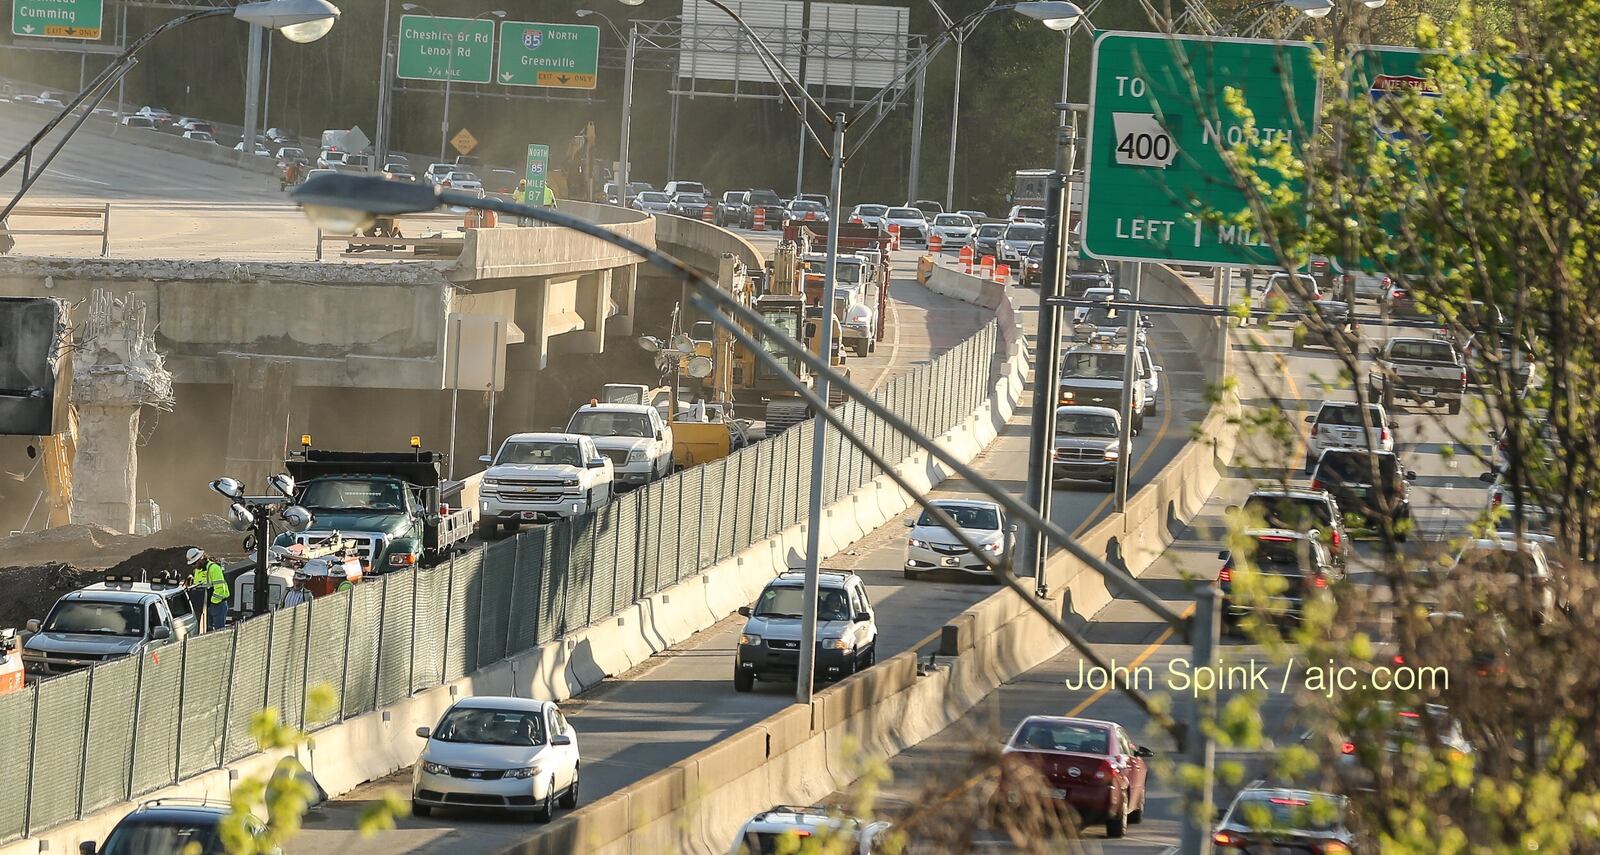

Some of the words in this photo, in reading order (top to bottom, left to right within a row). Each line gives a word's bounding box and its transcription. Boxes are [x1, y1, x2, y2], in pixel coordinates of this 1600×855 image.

[20, 6, 76, 23] Cumming
[405, 28, 453, 41] Cheshire
[474, 32, 488, 43] Rd
[524, 34, 541, 47] 85
[548, 30, 578, 41] NORTH
[420, 44, 452, 56] Lenox
[457, 46, 471, 57] Rd
[521, 55, 575, 68] Greenville
[427, 66, 441, 76] 3/4
[1115, 76, 1146, 98] TO
[529, 148, 548, 157] NORTH
[1117, 132, 1171, 160] 400
[531, 164, 543, 173] 85
[527, 179, 544, 189] MILE
[528, 190, 541, 201] 87
[1116, 218, 1175, 241] LEFT
[1193, 219, 1202, 248] 1
